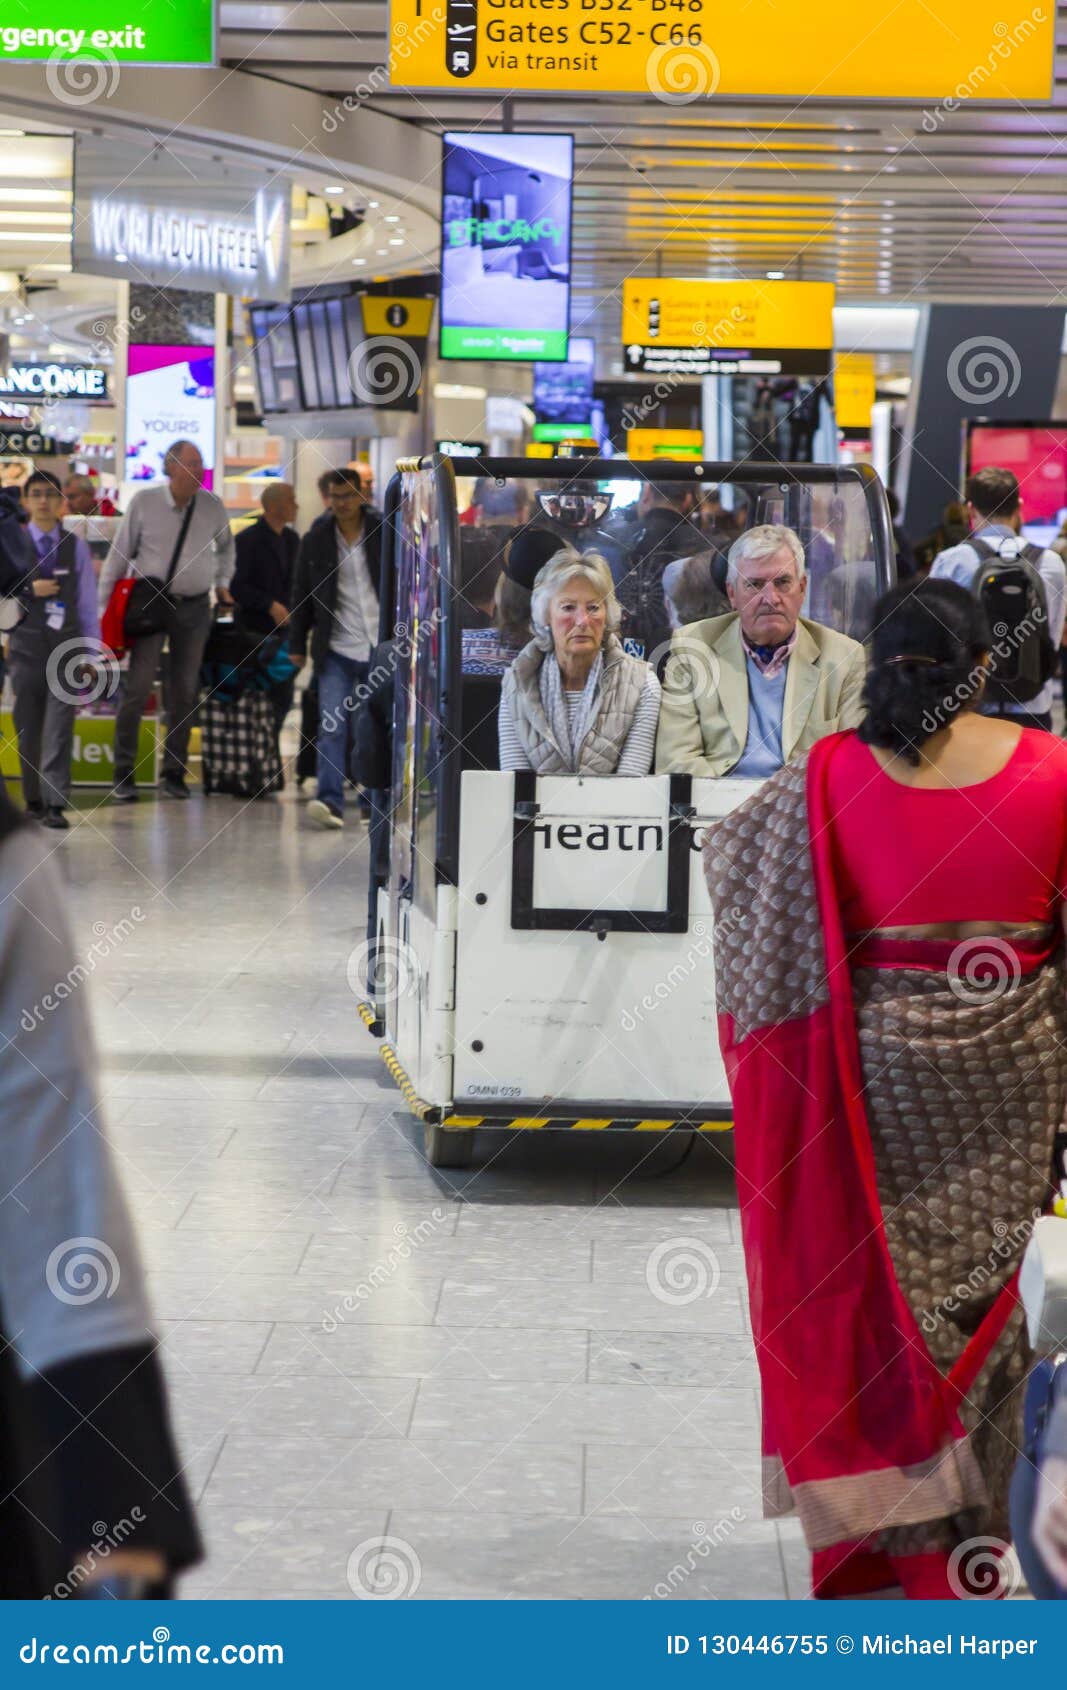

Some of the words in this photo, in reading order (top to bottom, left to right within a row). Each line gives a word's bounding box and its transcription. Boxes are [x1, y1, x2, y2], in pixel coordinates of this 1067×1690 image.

[0, 27, 85, 54] gency
[90, 25, 145, 49] exit
[486, 20, 569, 43] Gates
[579, 22, 702, 46] C52-C66
[486, 53, 518, 69] via
[527, 52, 598, 71] transit
[143, 420, 199, 433] YOURS
